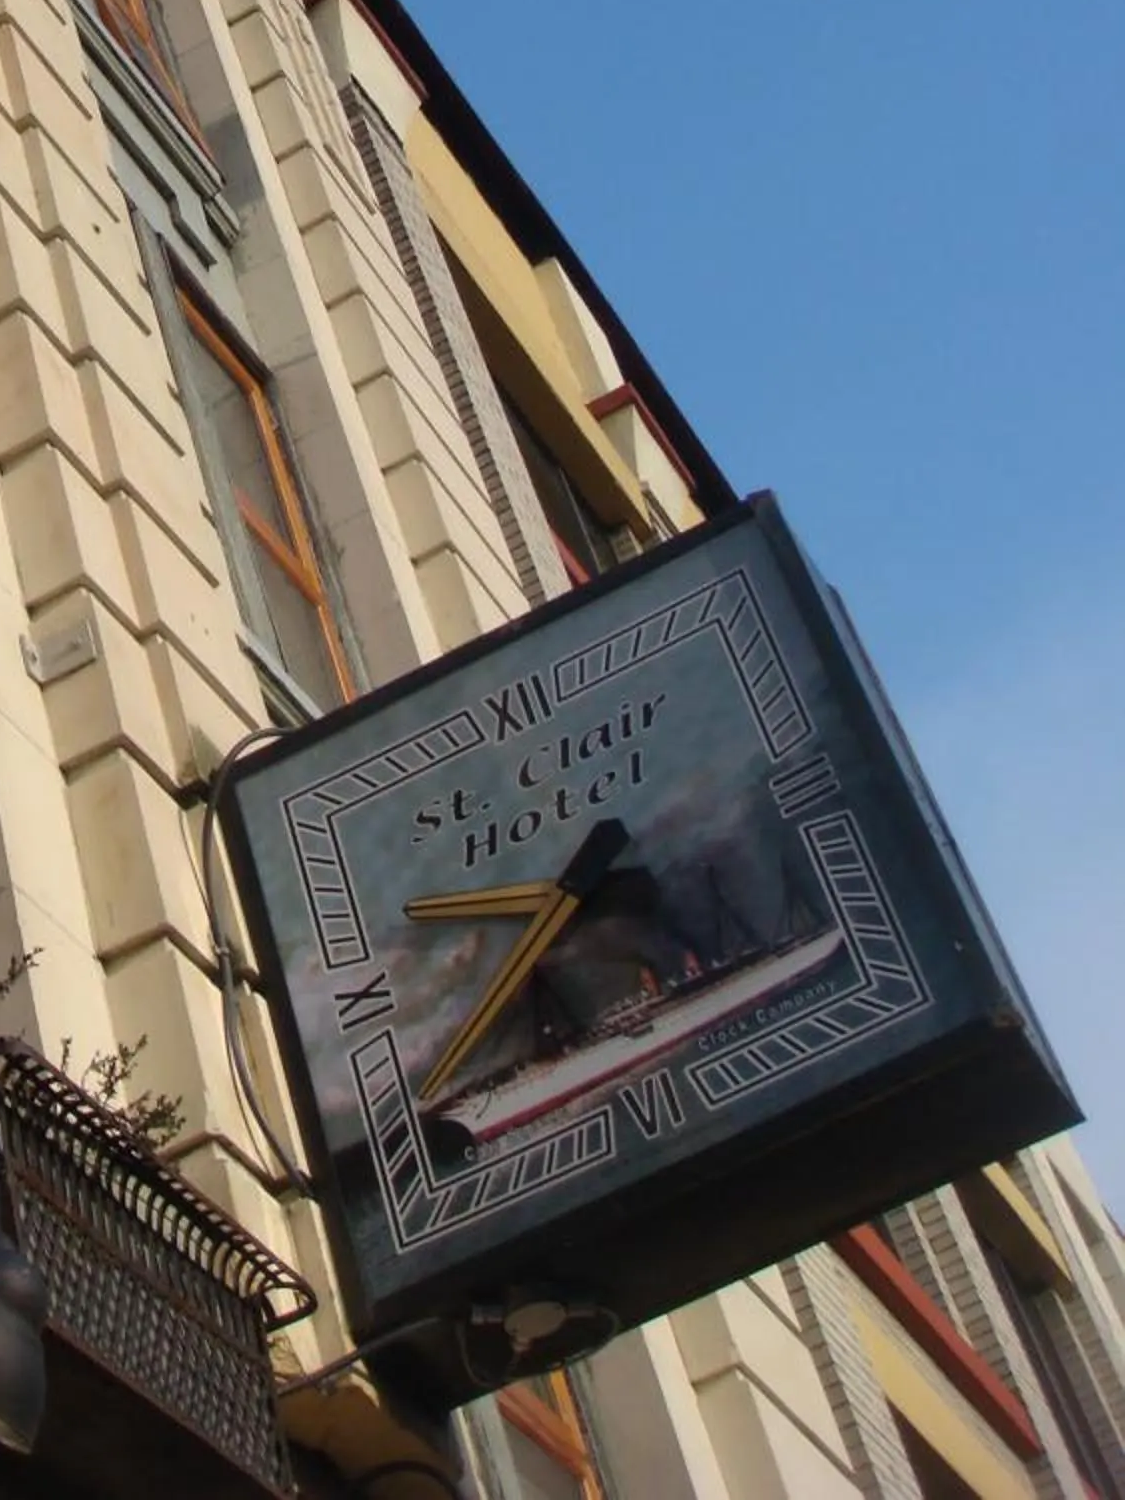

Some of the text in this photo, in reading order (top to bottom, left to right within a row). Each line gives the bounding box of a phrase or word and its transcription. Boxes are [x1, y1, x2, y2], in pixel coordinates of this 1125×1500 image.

[484, 673, 555, 743] XII
[411, 690, 669, 846] St. Clair
[770, 753, 841, 817] III
[461, 749, 648, 869] Hotel
[618, 1068, 686, 1139] VI
